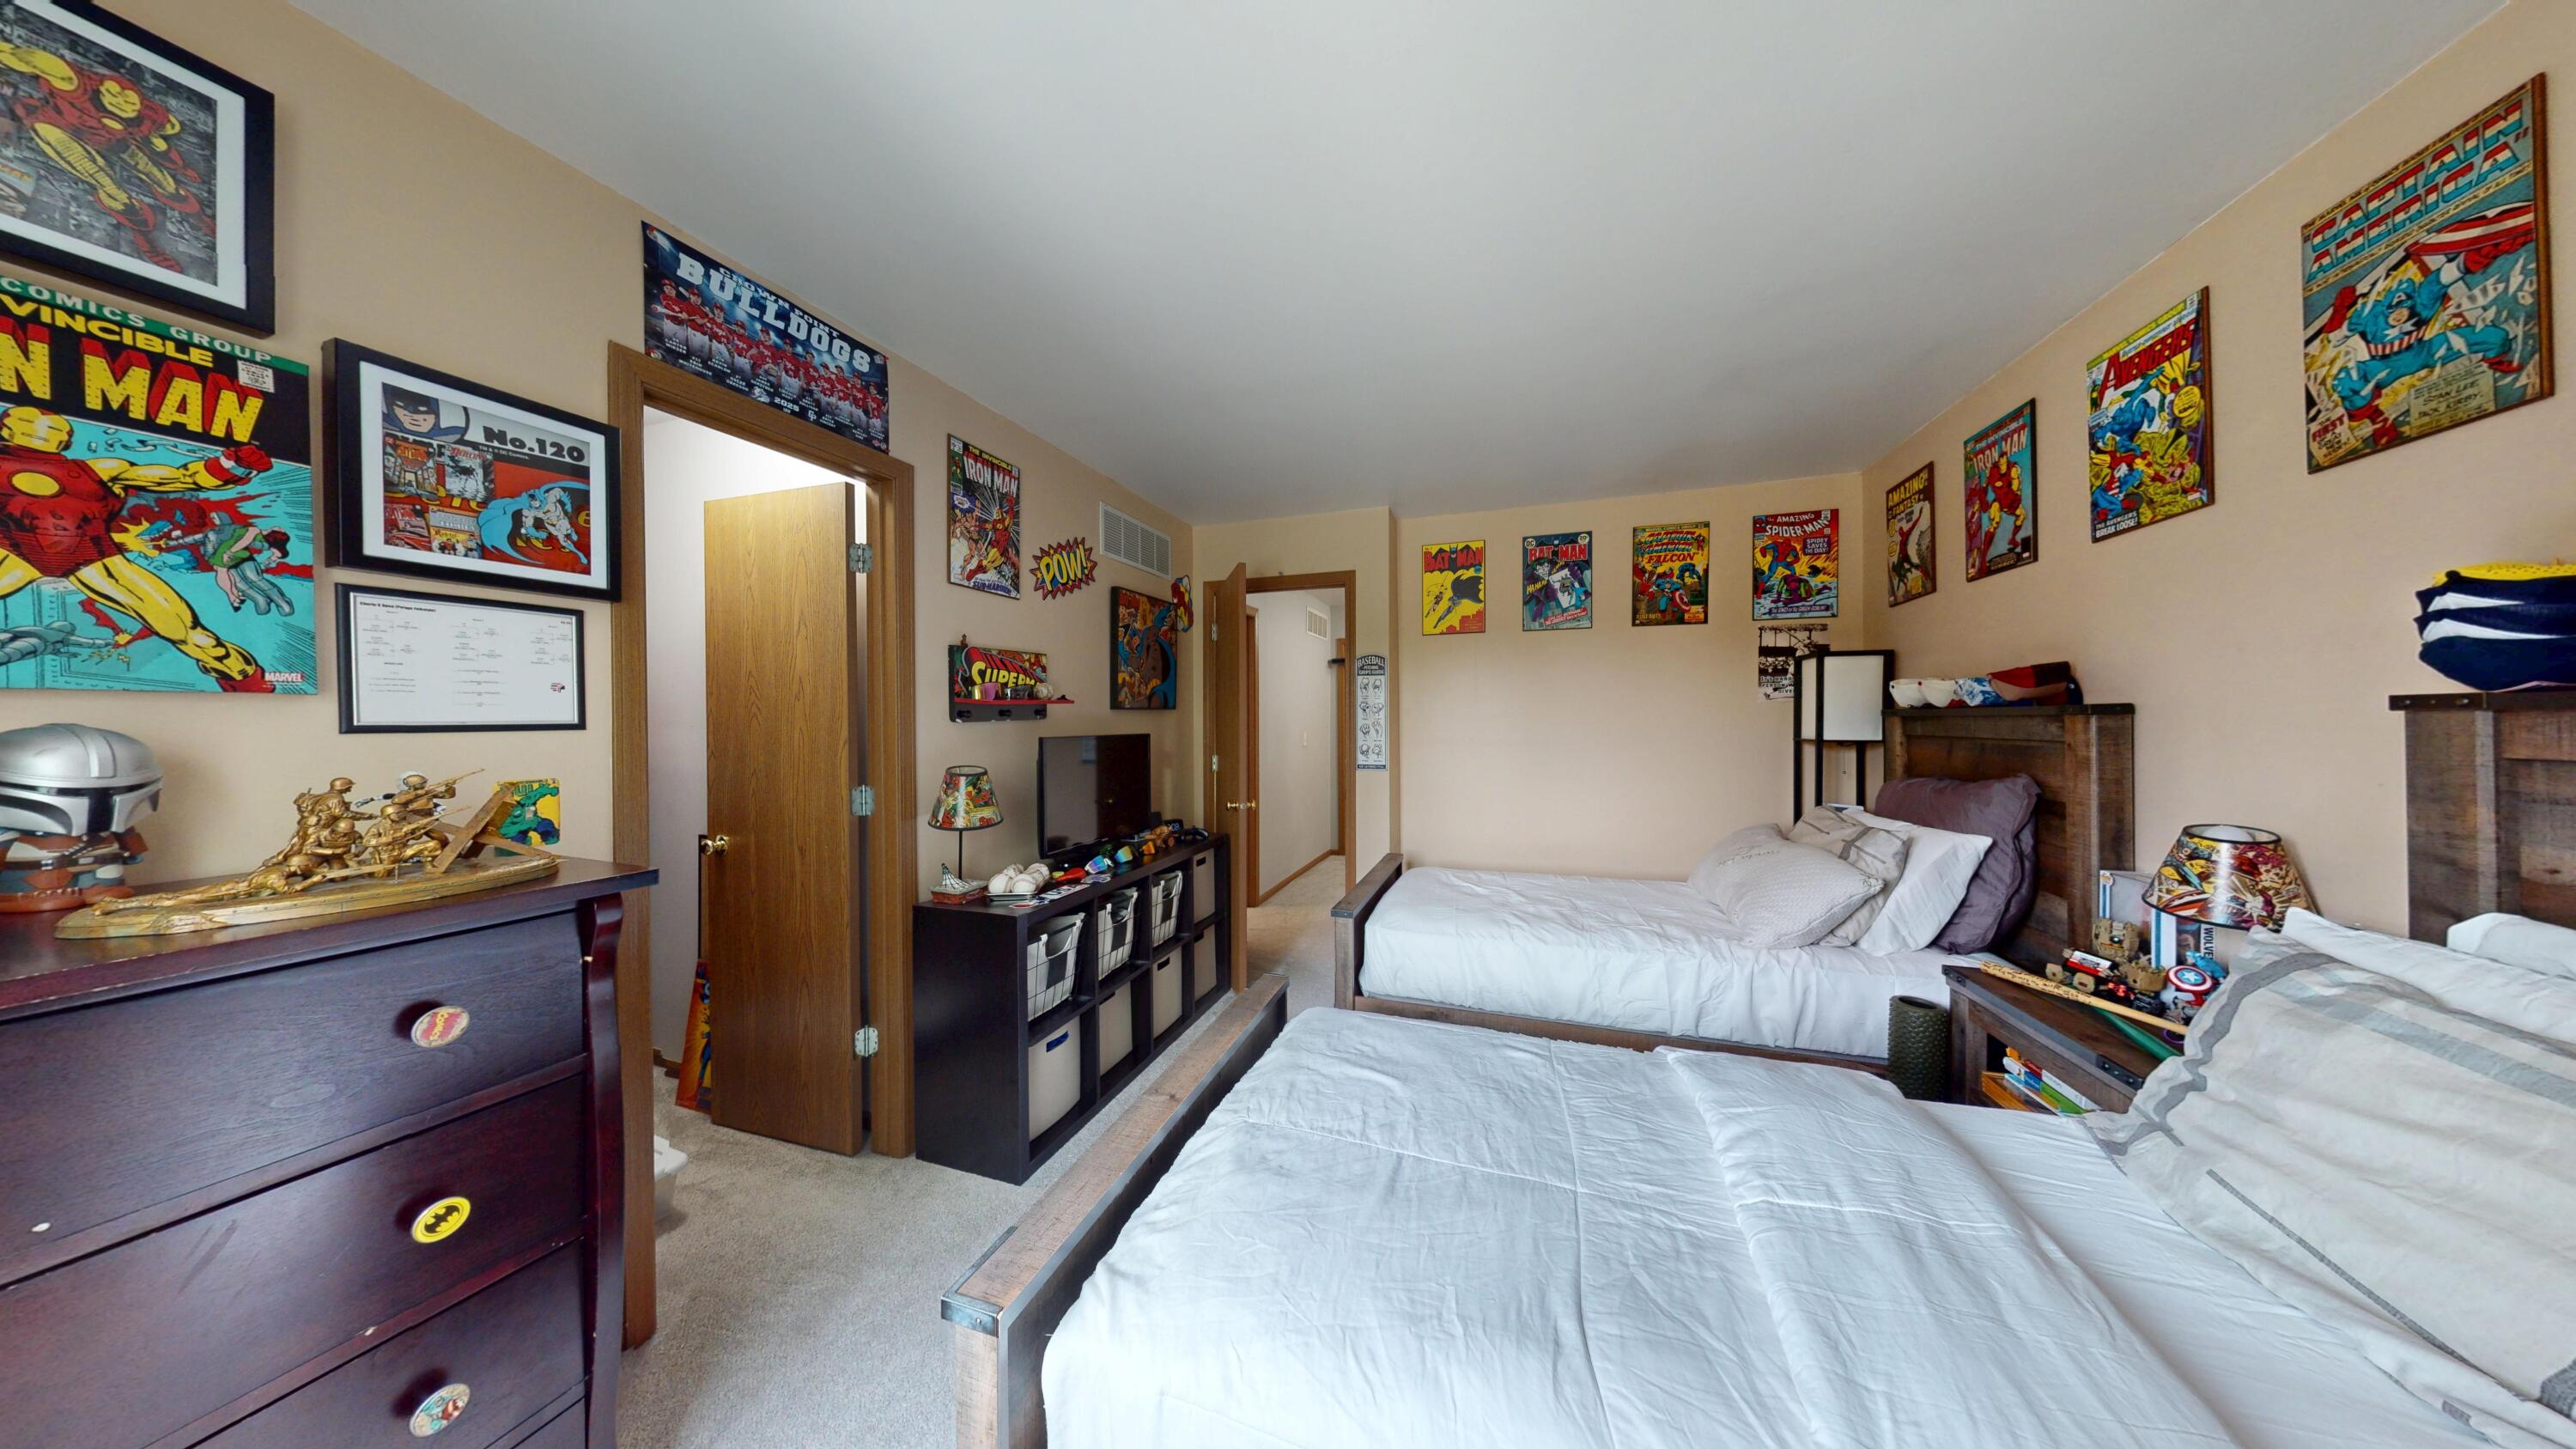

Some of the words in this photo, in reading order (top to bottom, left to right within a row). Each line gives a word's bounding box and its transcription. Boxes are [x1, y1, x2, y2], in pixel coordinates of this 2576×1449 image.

[677, 253, 871, 373] BULLDOGS
[720, 267, 790, 309] CROWN
[793, 307, 841, 338] POINT
[1, 277, 146, 327] COMICS
[170, 326, 272, 362] GROUP
[2099, 317, 2198, 408] AVENGERS
[82, 337, 265, 442] MAN
[774, 397, 799, 411] 2025
[483, 425, 586, 462] No.120
[2312, 413, 2345, 442] FIRST
[969, 446, 980, 455] THE
[1973, 445, 1999, 474] IRON
[2002, 427, 2028, 457] MAN
[963, 454, 992, 488] IRON
[993, 469, 1018, 497] MAN
[1888, 472, 1924, 508] AMAZING
[1777, 513, 1814, 522] AMAZING
[1893, 494, 1919, 515] FANTASY
[2105, 511, 2136, 526] AVENGERS
[1765, 518, 1829, 537] SPIDER-MAN
[2096, 526, 2116, 538] BREAK
[2117, 516, 2138, 531] LOOSE!
[1039, 543, 1089, 591] POW!
[264, 672, 303, 682] MARVEL
[1358, 655, 1385, 667] BASEBALL
[2203, 927, 2214, 959] WOLVE
